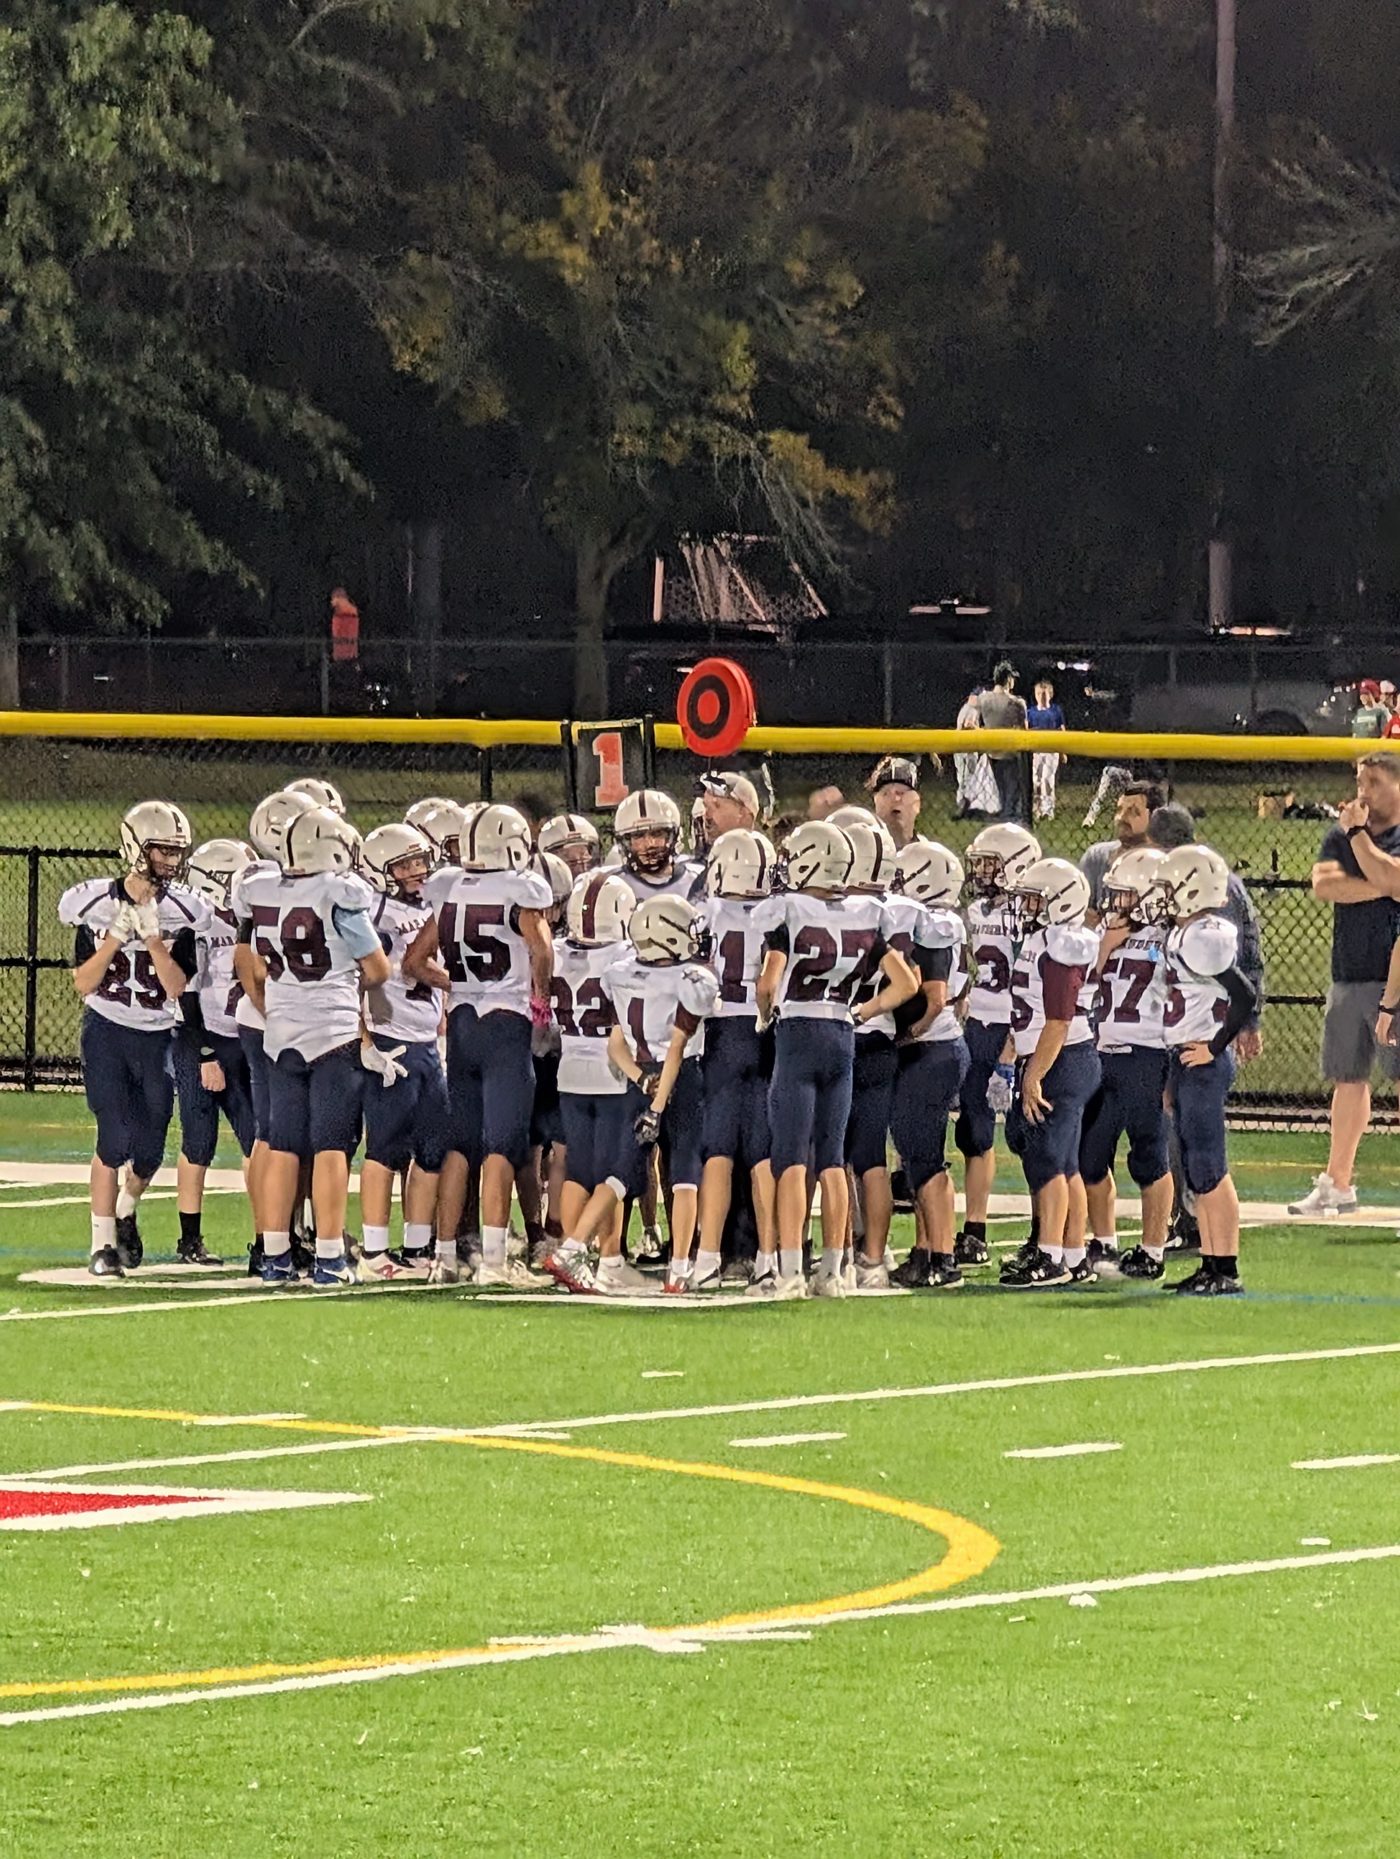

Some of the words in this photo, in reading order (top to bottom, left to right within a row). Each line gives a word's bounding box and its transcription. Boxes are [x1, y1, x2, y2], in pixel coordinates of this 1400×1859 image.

[592, 732, 629, 807] 1
[251, 904, 332, 983] 58
[437, 902, 512, 983] 15
[783, 924, 880, 1004] 27
